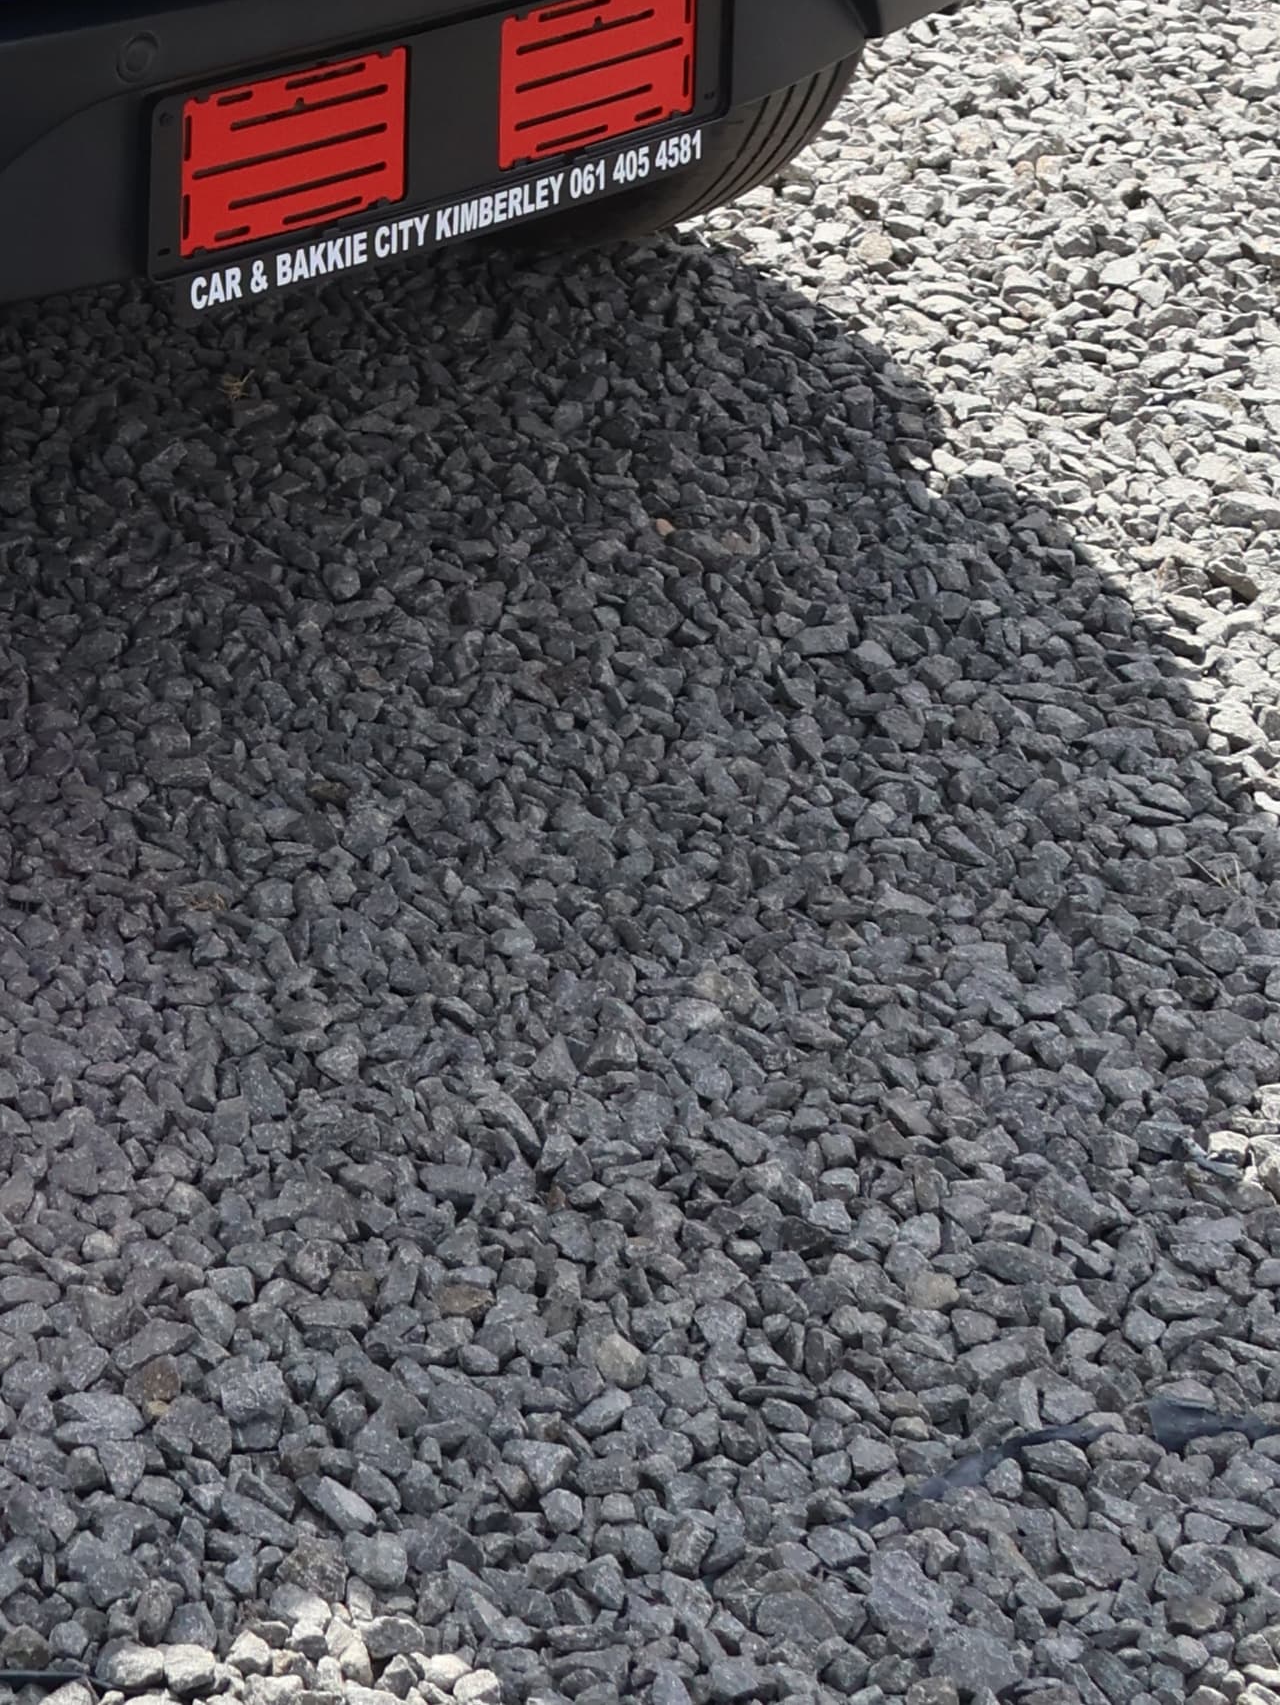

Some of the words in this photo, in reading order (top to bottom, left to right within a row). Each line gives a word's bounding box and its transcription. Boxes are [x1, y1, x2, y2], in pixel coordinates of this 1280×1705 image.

[192, 267, 242, 309] CAR
[249, 260, 269, 294] &
[276, 232, 368, 287] BAKKIE
[374, 213, 432, 259] CITY
[436, 173, 566, 240] KIMBERLEY
[569, 159, 606, 199] 061
[612, 146, 650, 186] 405
[655, 130, 703, 170] 4581
